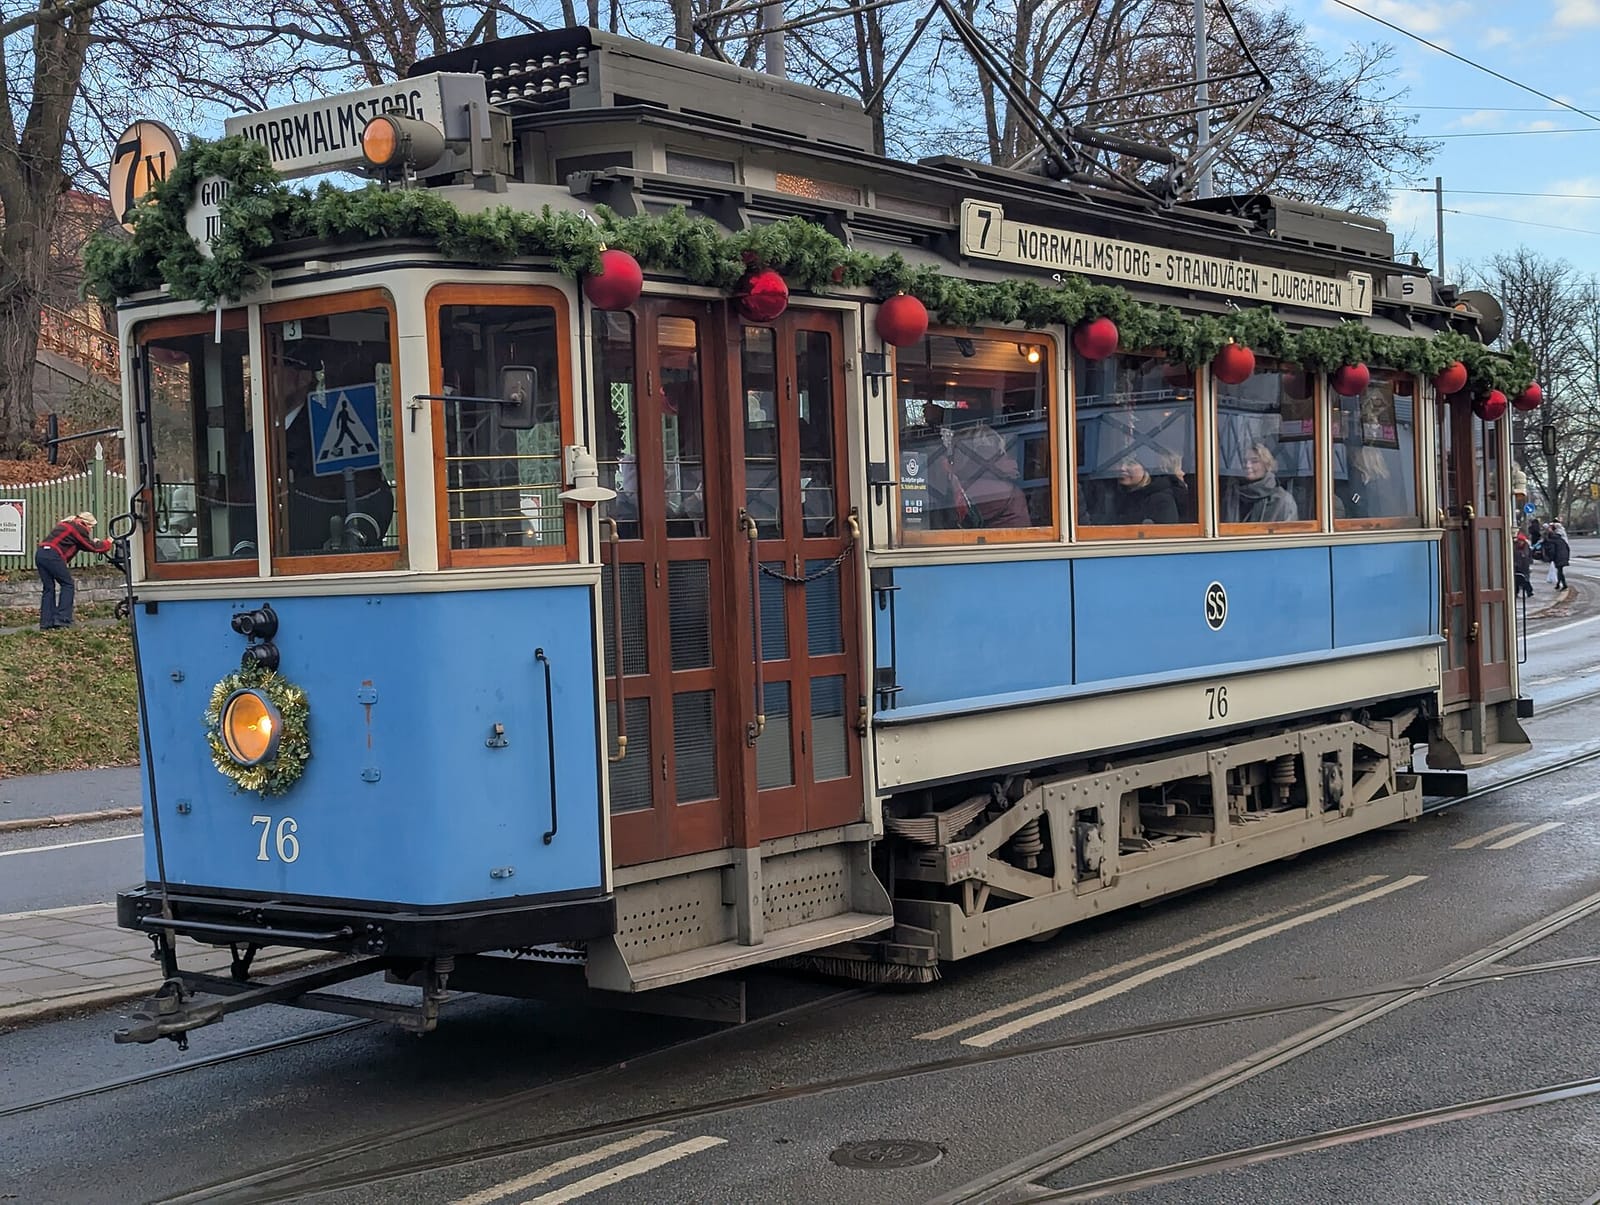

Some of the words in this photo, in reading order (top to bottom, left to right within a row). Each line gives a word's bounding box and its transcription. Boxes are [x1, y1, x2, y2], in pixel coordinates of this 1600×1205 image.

[978, 209, 992, 250] 7
[1017, 228, 1150, 277] NORRMALMSTORG
[1166, 254, 1259, 294] STRANDVÄGEN
[1271, 272, 1342, 307] DJURGÅRDEN
[1357, 279, 1366, 309] 7
[1402, 282, 1414, 295] S
[1208, 591, 1225, 620] SS
[1205, 686, 1229, 721] 76
[251, 815, 300, 863] 76
